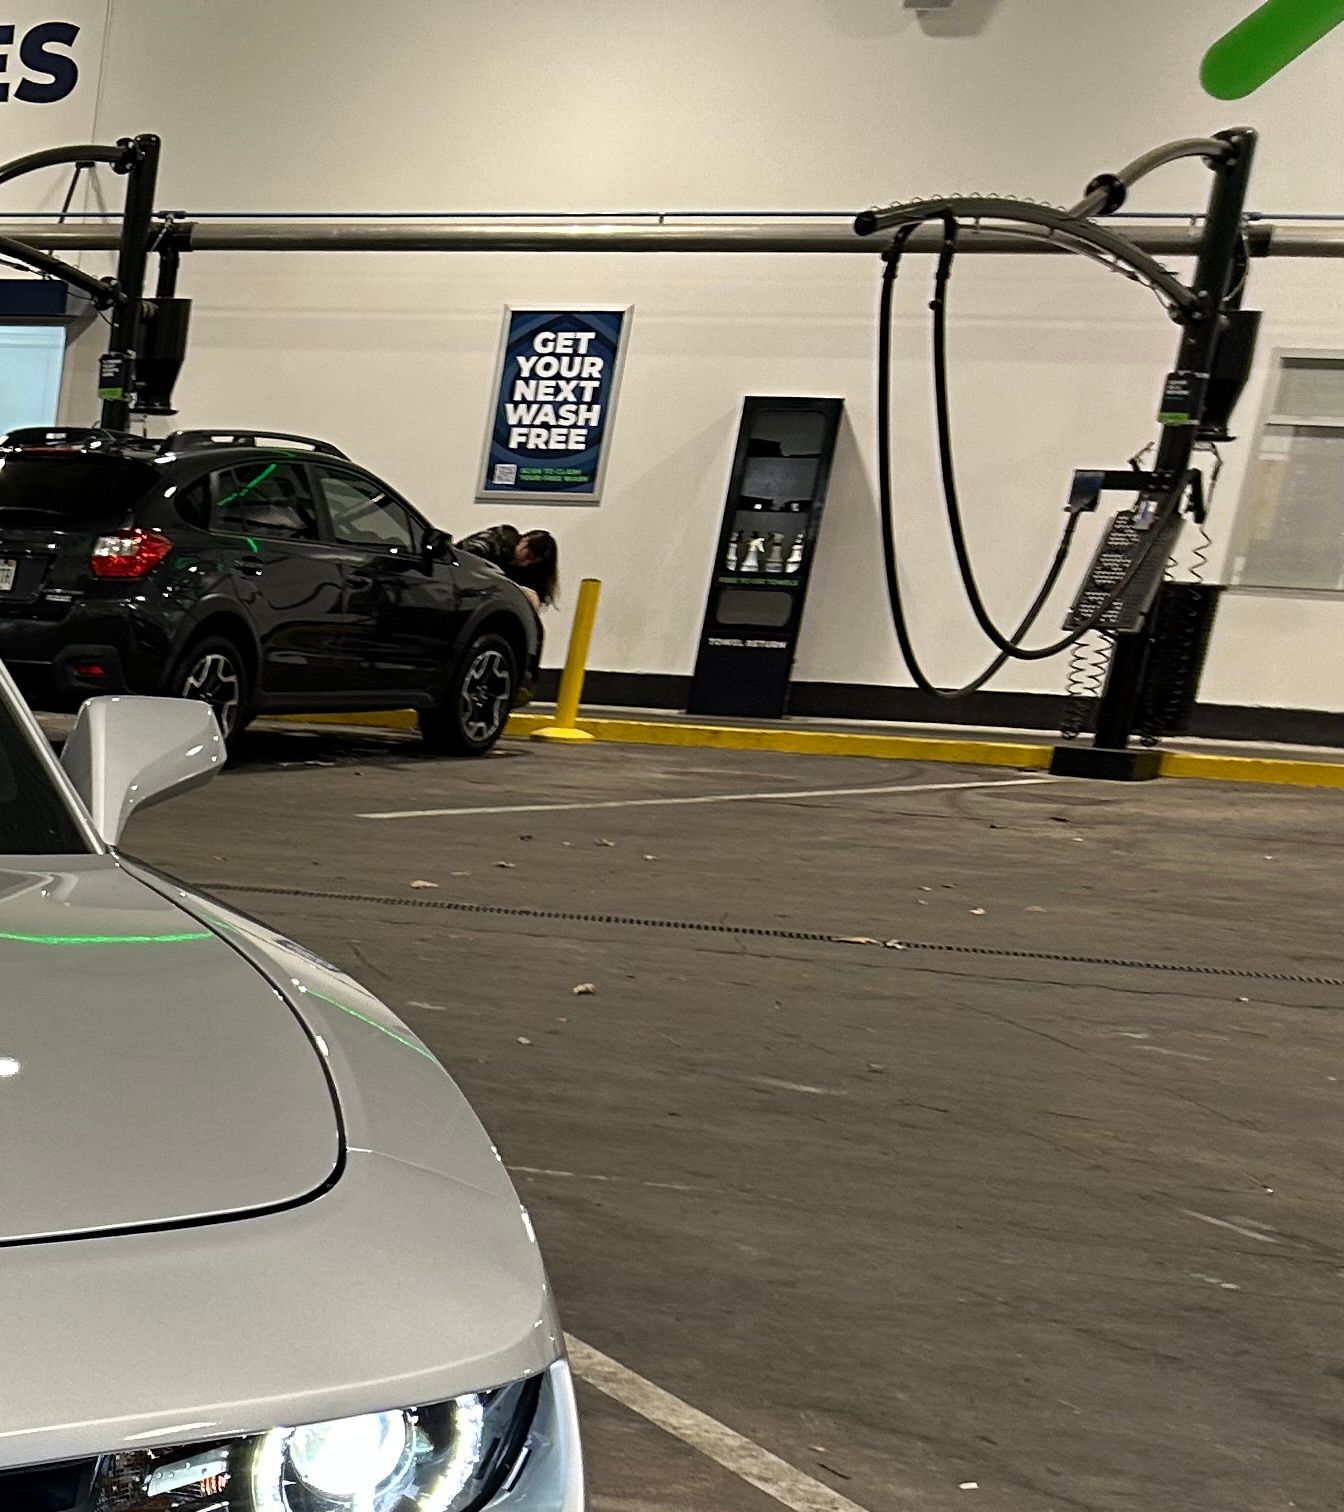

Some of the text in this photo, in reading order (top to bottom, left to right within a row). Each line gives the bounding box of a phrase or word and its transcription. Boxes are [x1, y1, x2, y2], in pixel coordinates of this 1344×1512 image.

[533, 331, 596, 354] GET
[516, 356, 604, 378] YOUR
[513, 380, 600, 402] NEXT
[505, 403, 602, 426] WASH
[508, 427, 589, 450] FREE
